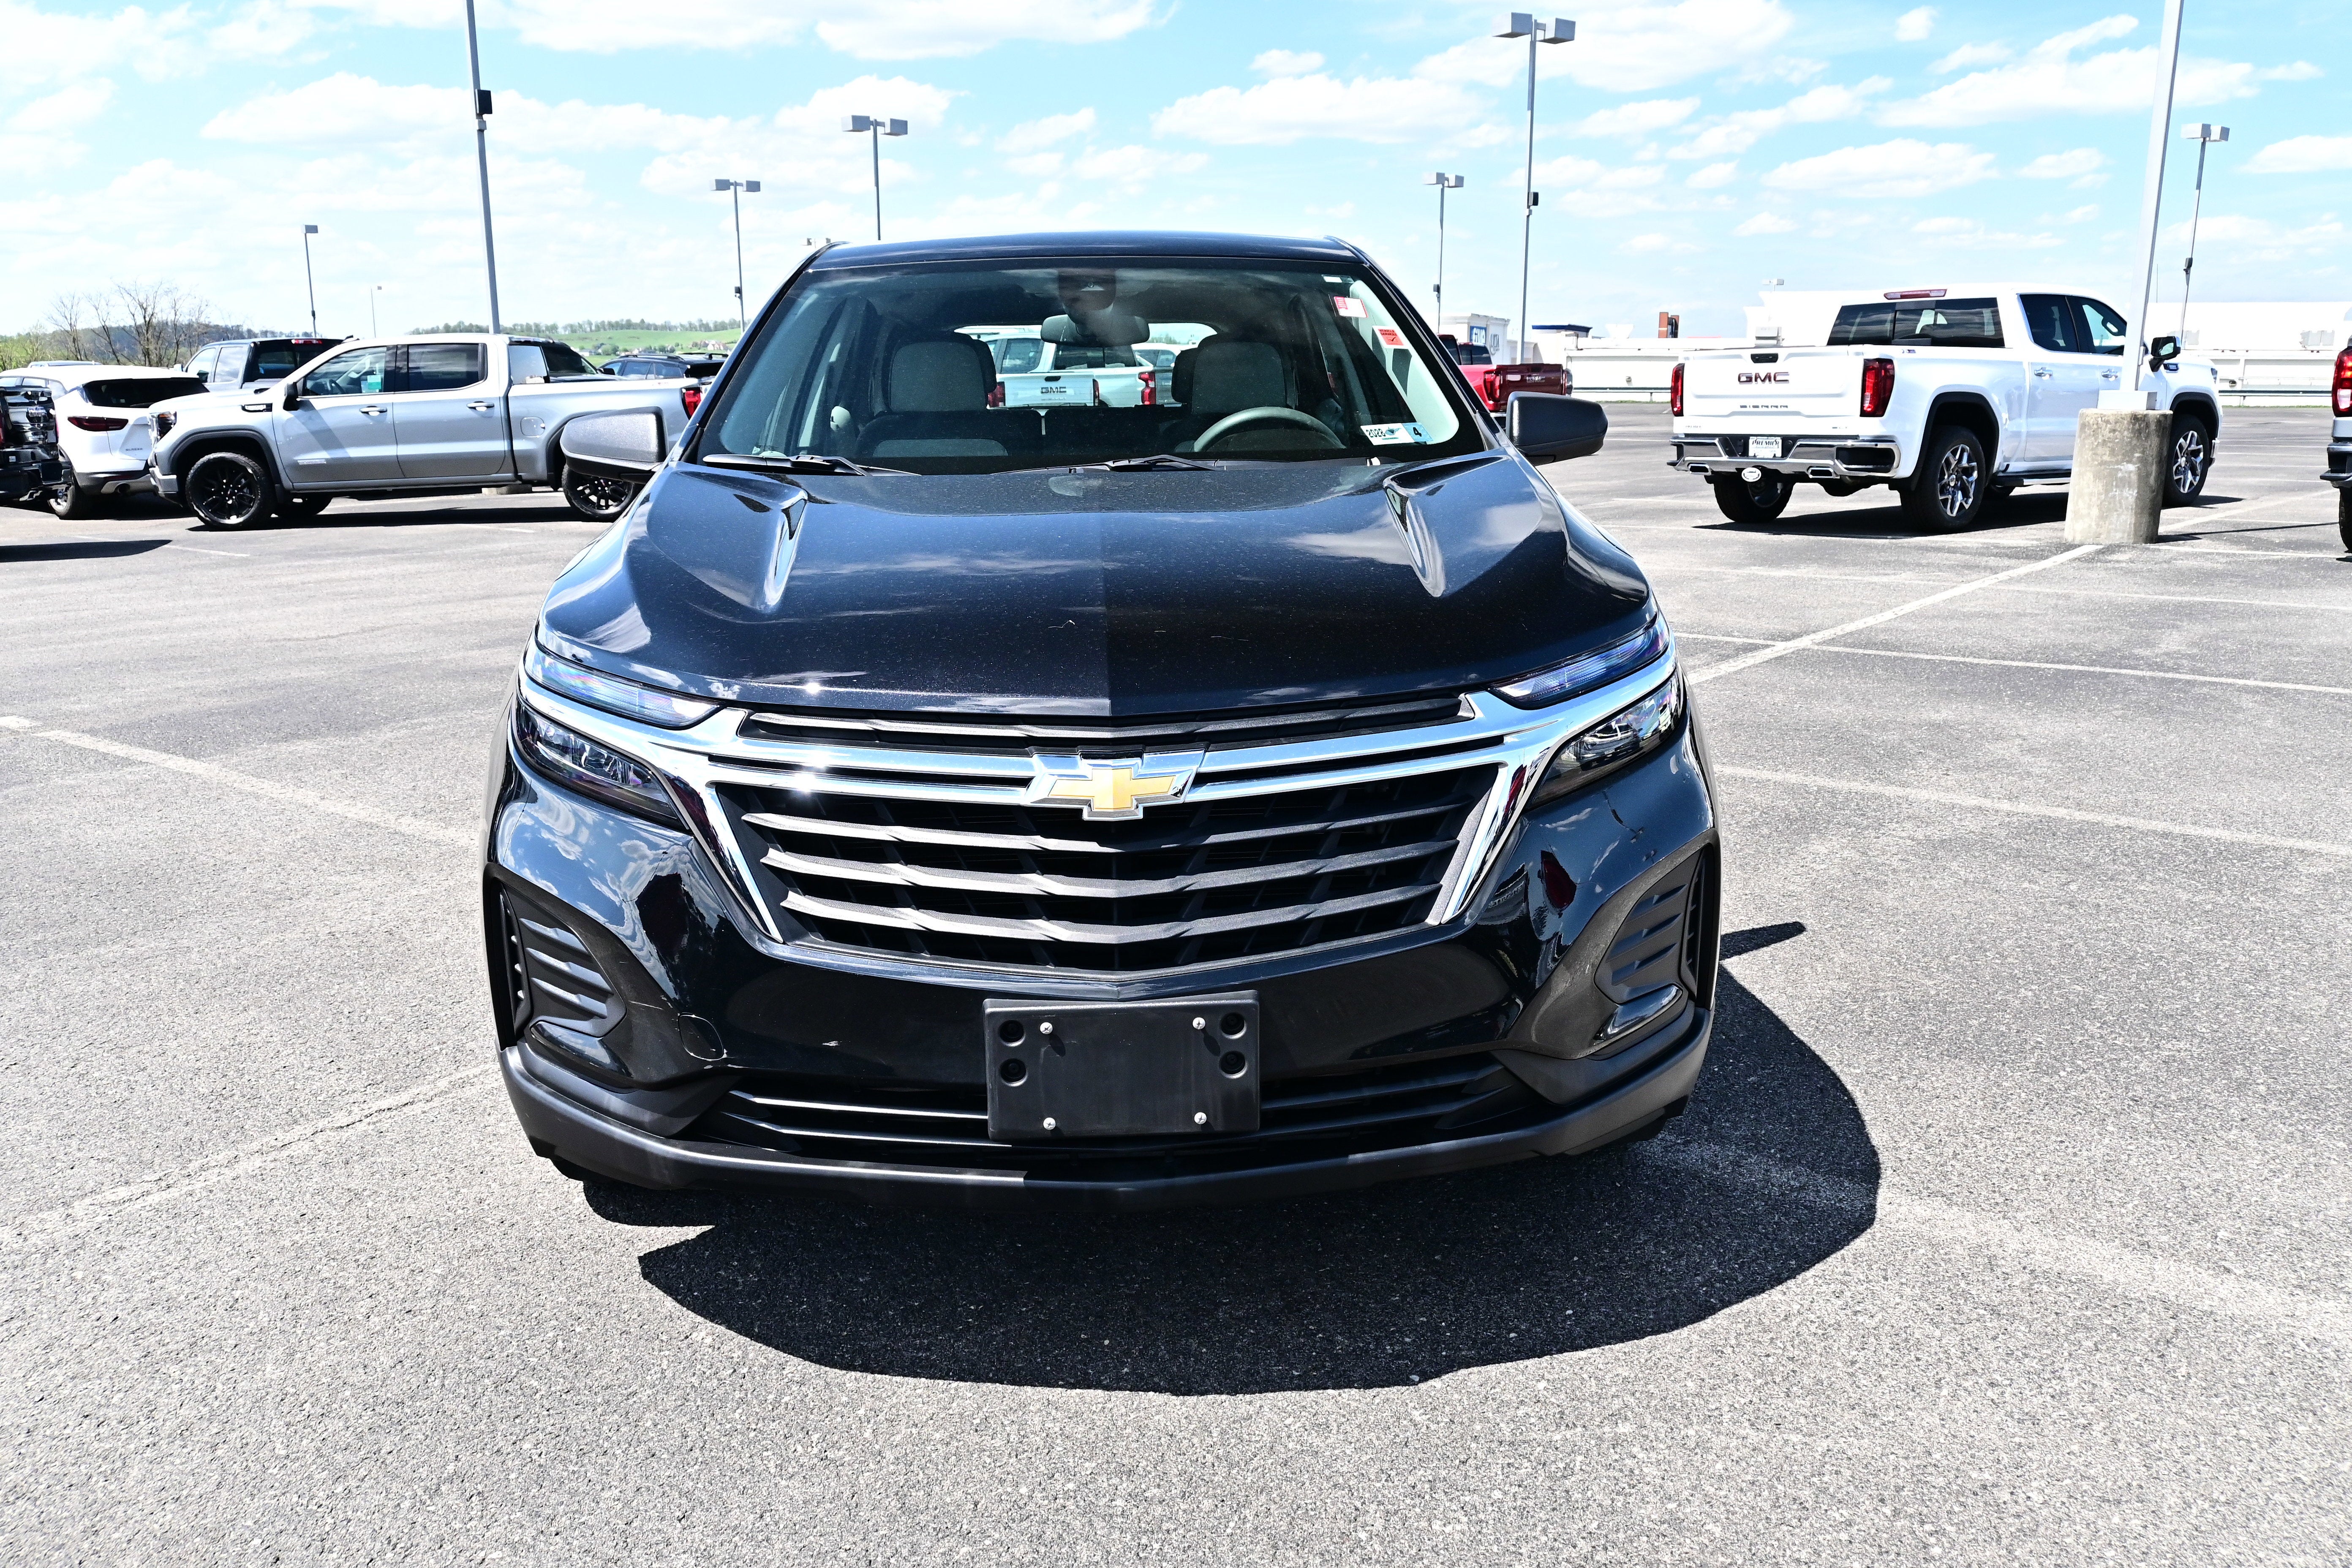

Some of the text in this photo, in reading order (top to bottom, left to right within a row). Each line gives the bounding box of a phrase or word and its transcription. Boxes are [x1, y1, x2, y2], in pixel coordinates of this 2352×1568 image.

[1738, 372, 1789, 384] GMC
[1040, 386, 1067, 394] GMC
[1366, 427, 1422, 438] 2028 4
